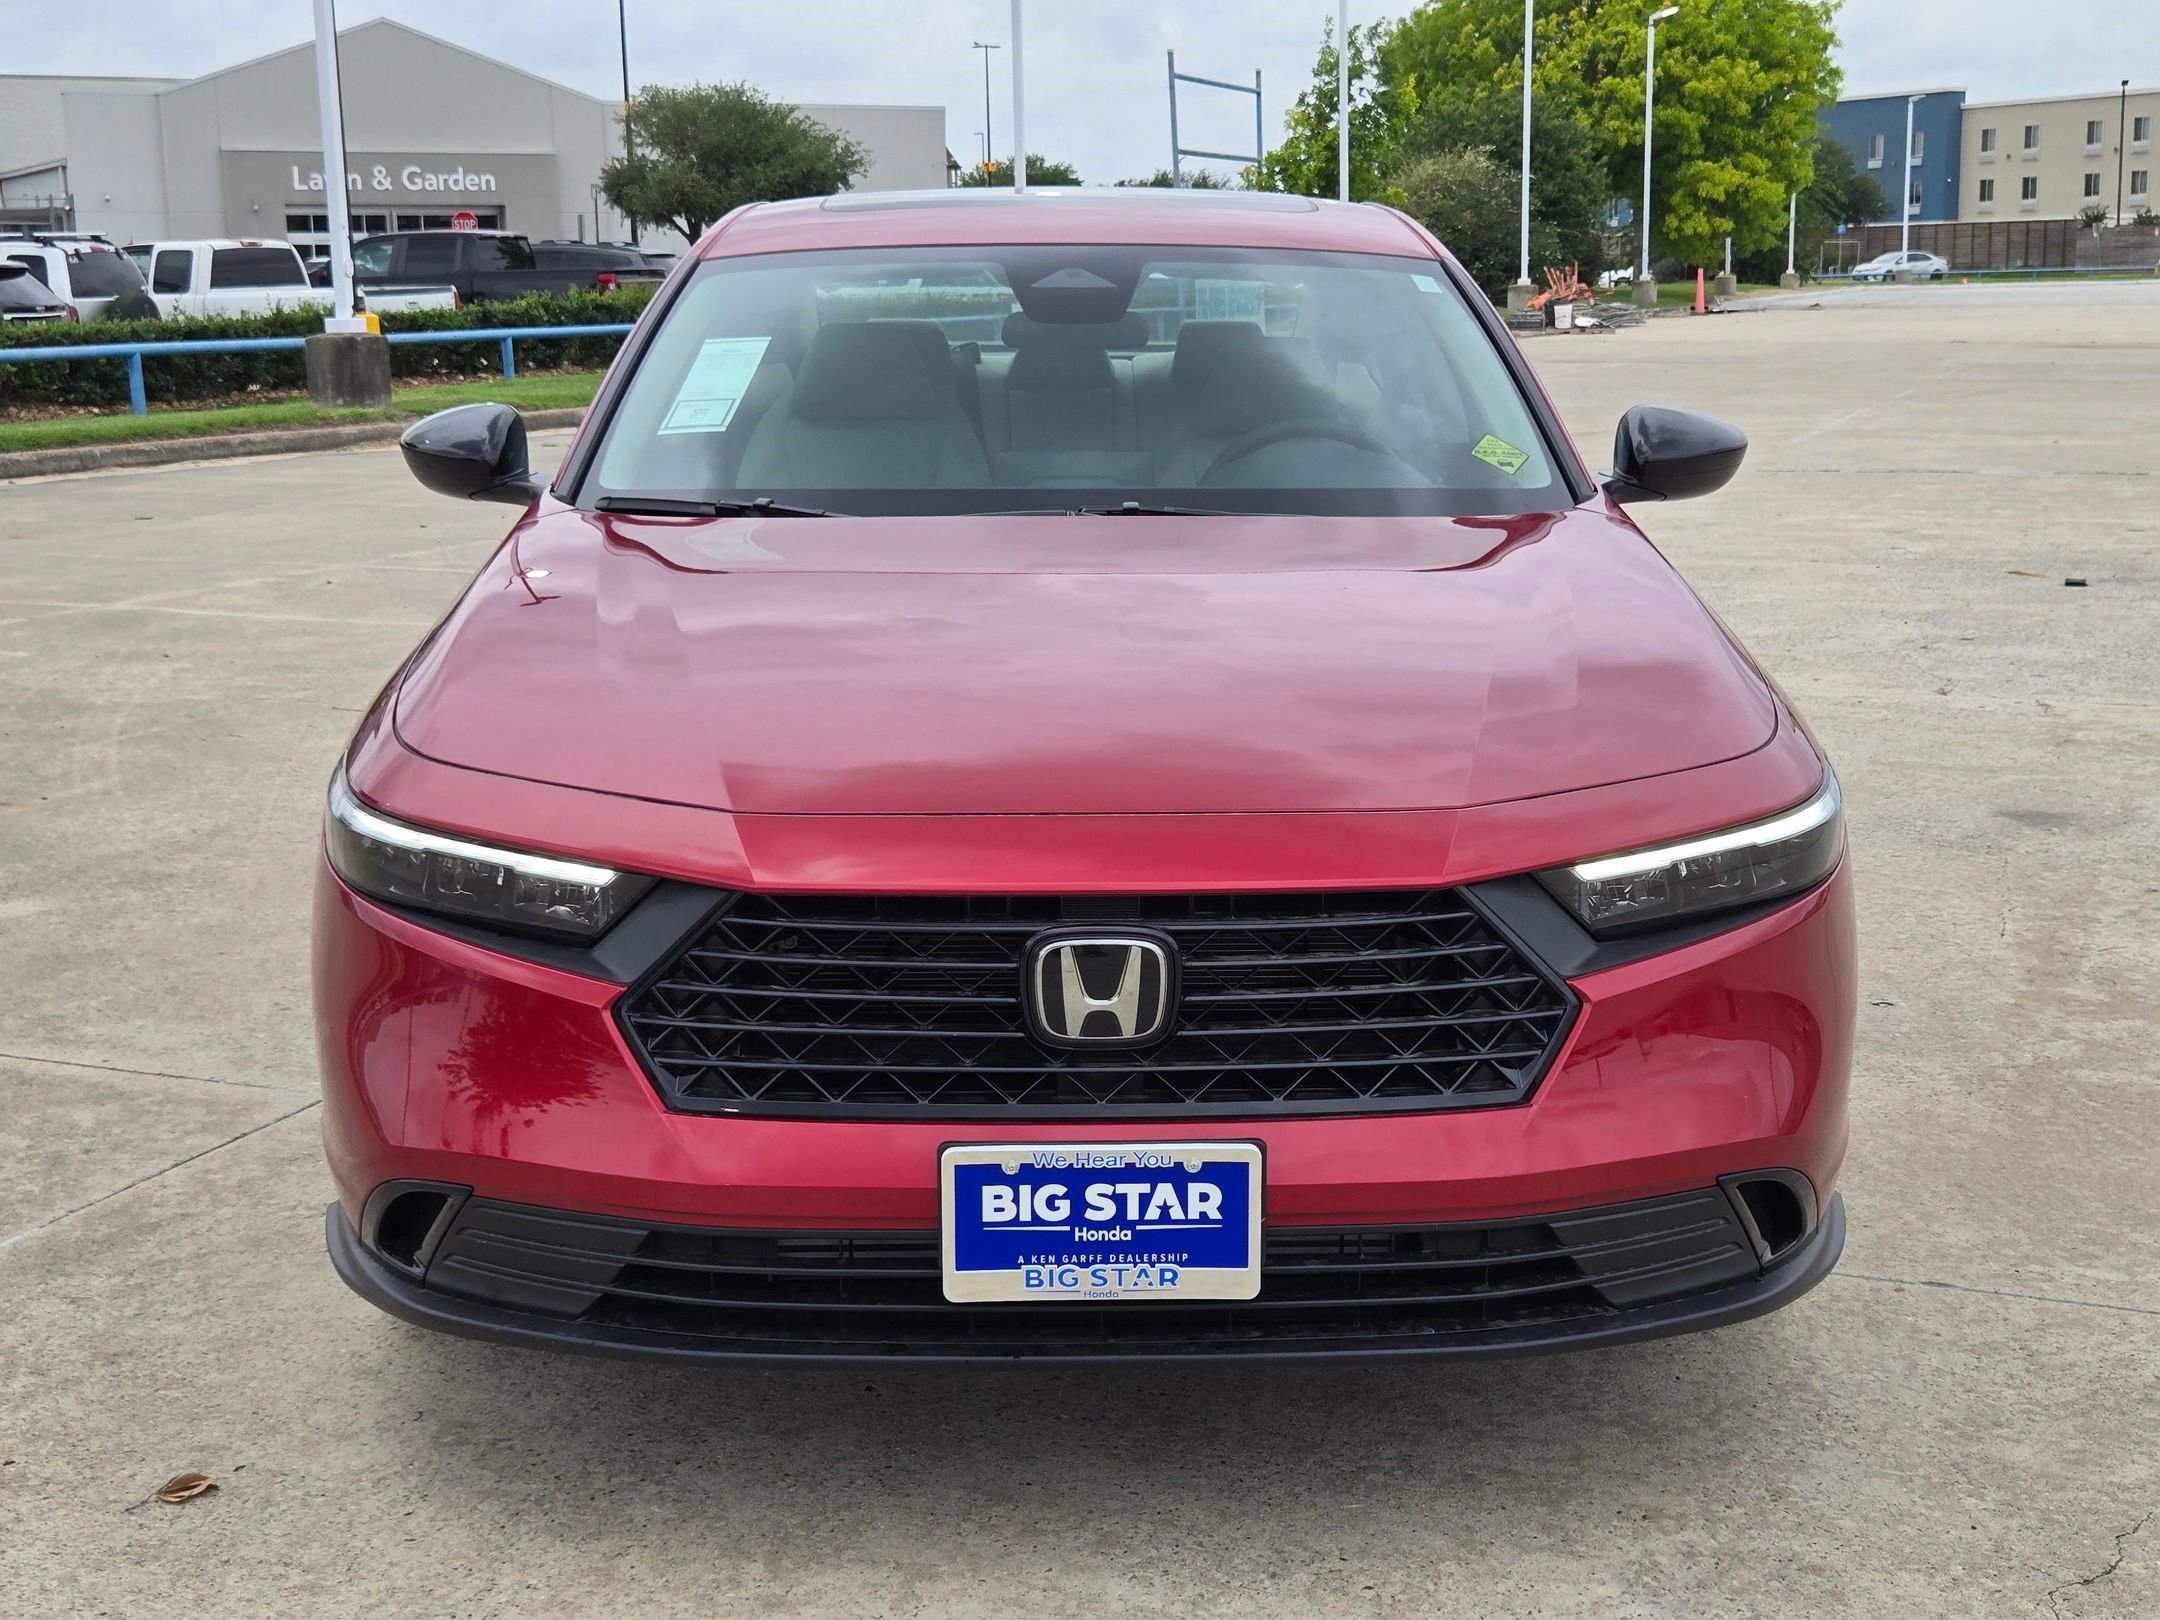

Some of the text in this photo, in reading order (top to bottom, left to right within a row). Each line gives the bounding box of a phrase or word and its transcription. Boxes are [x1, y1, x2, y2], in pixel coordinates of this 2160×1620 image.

[292, 166, 497, 191] Lan & Garden
[454, 219, 476, 230] STOP
[1032, 1151, 1173, 1168] We Hear You
[981, 1182, 1223, 1223] BIG STAR
[1074, 1226, 1132, 1242] Honda
[1017, 1252, 1189, 1264] A KEN GARFF DEALERSHIP
[1024, 1266, 1180, 1289] BIG STAR
[1083, 1289, 1120, 1299] Honda
